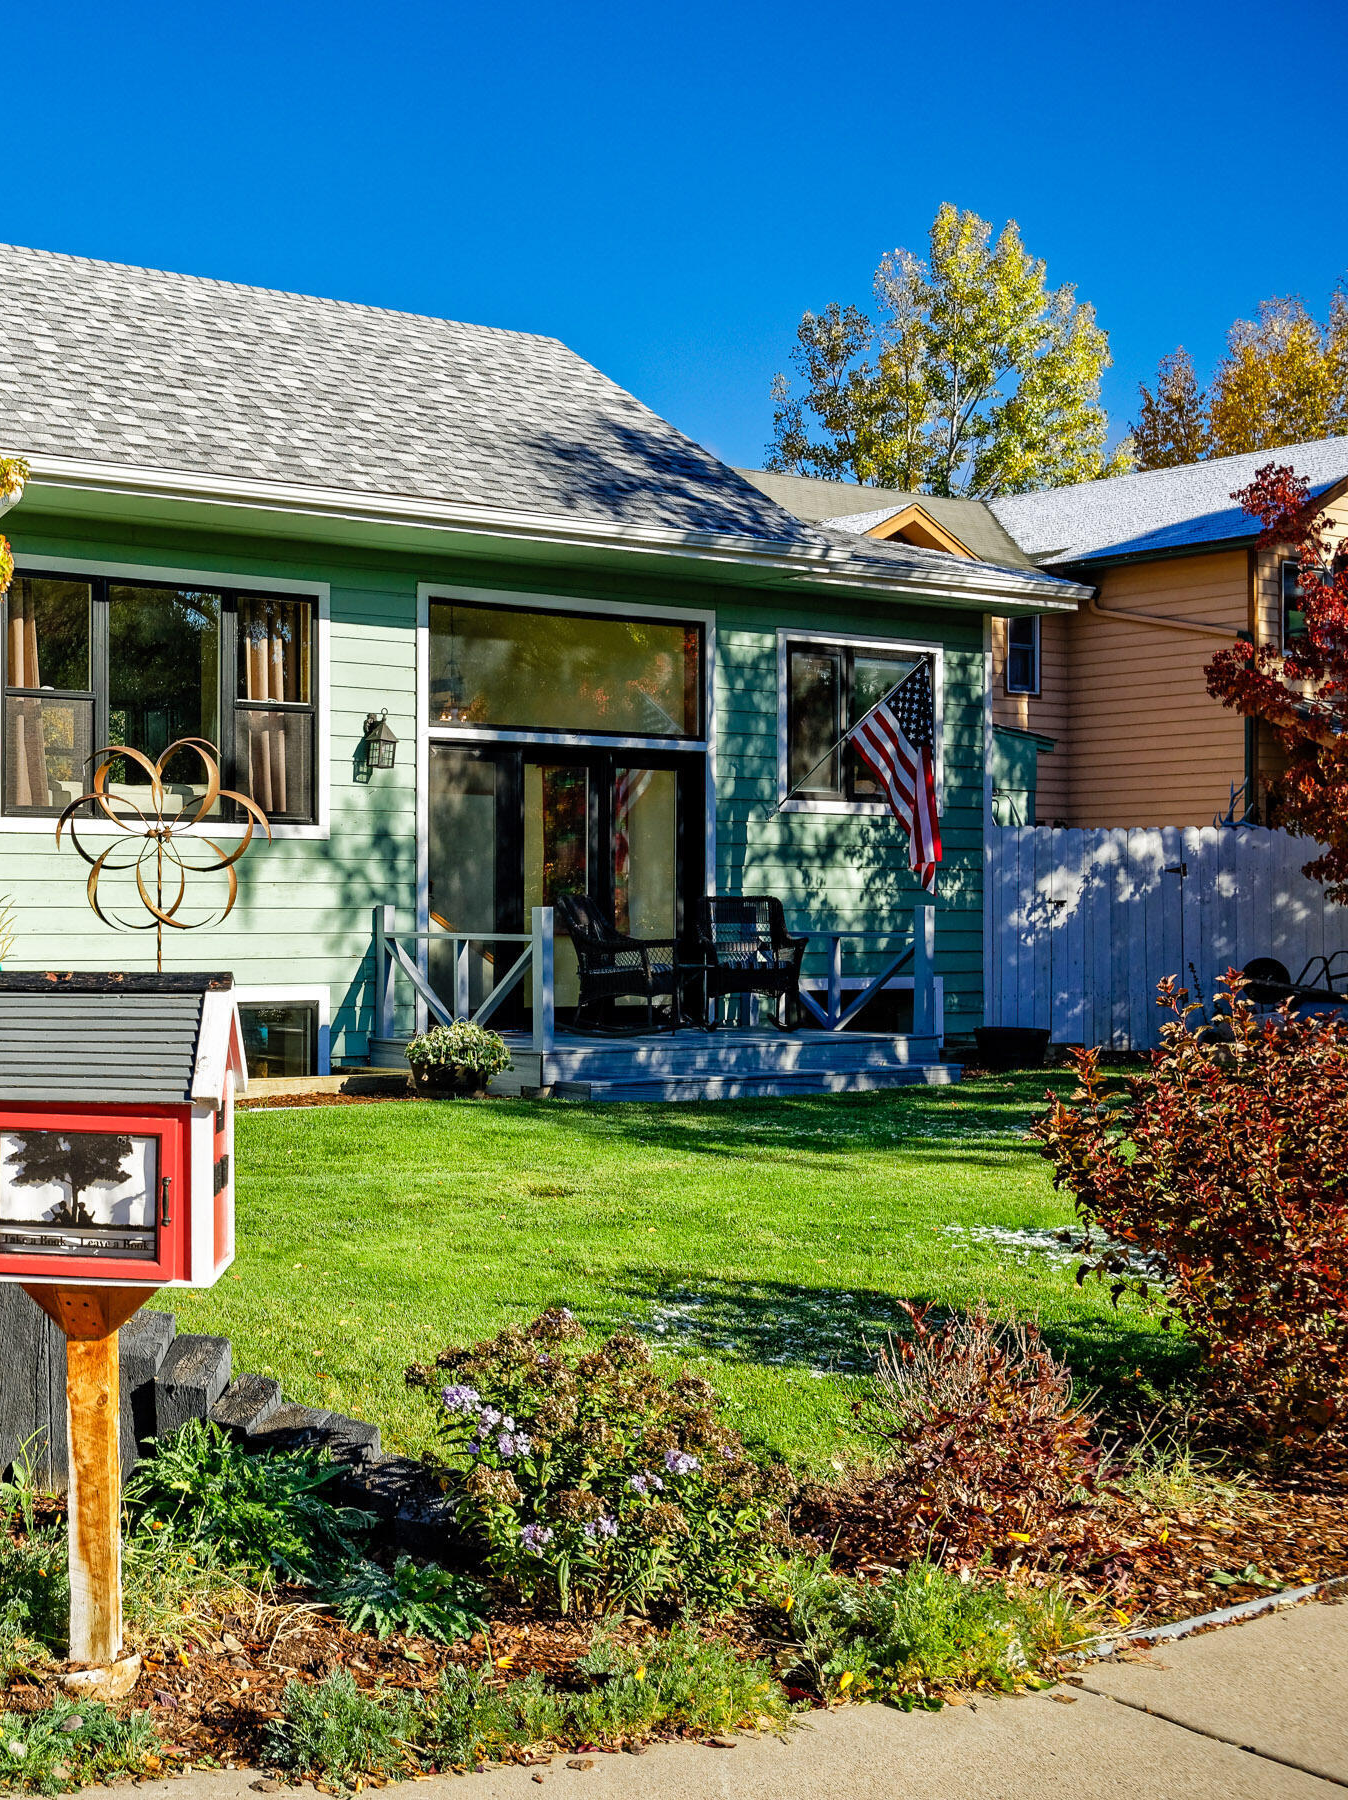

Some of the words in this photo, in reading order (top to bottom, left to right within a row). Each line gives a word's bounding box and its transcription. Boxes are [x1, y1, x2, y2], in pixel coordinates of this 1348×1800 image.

[4, 1234, 28, 1245] Take
[41, 1235, 66, 1246] Book
[124, 1239, 149, 1250] Book
